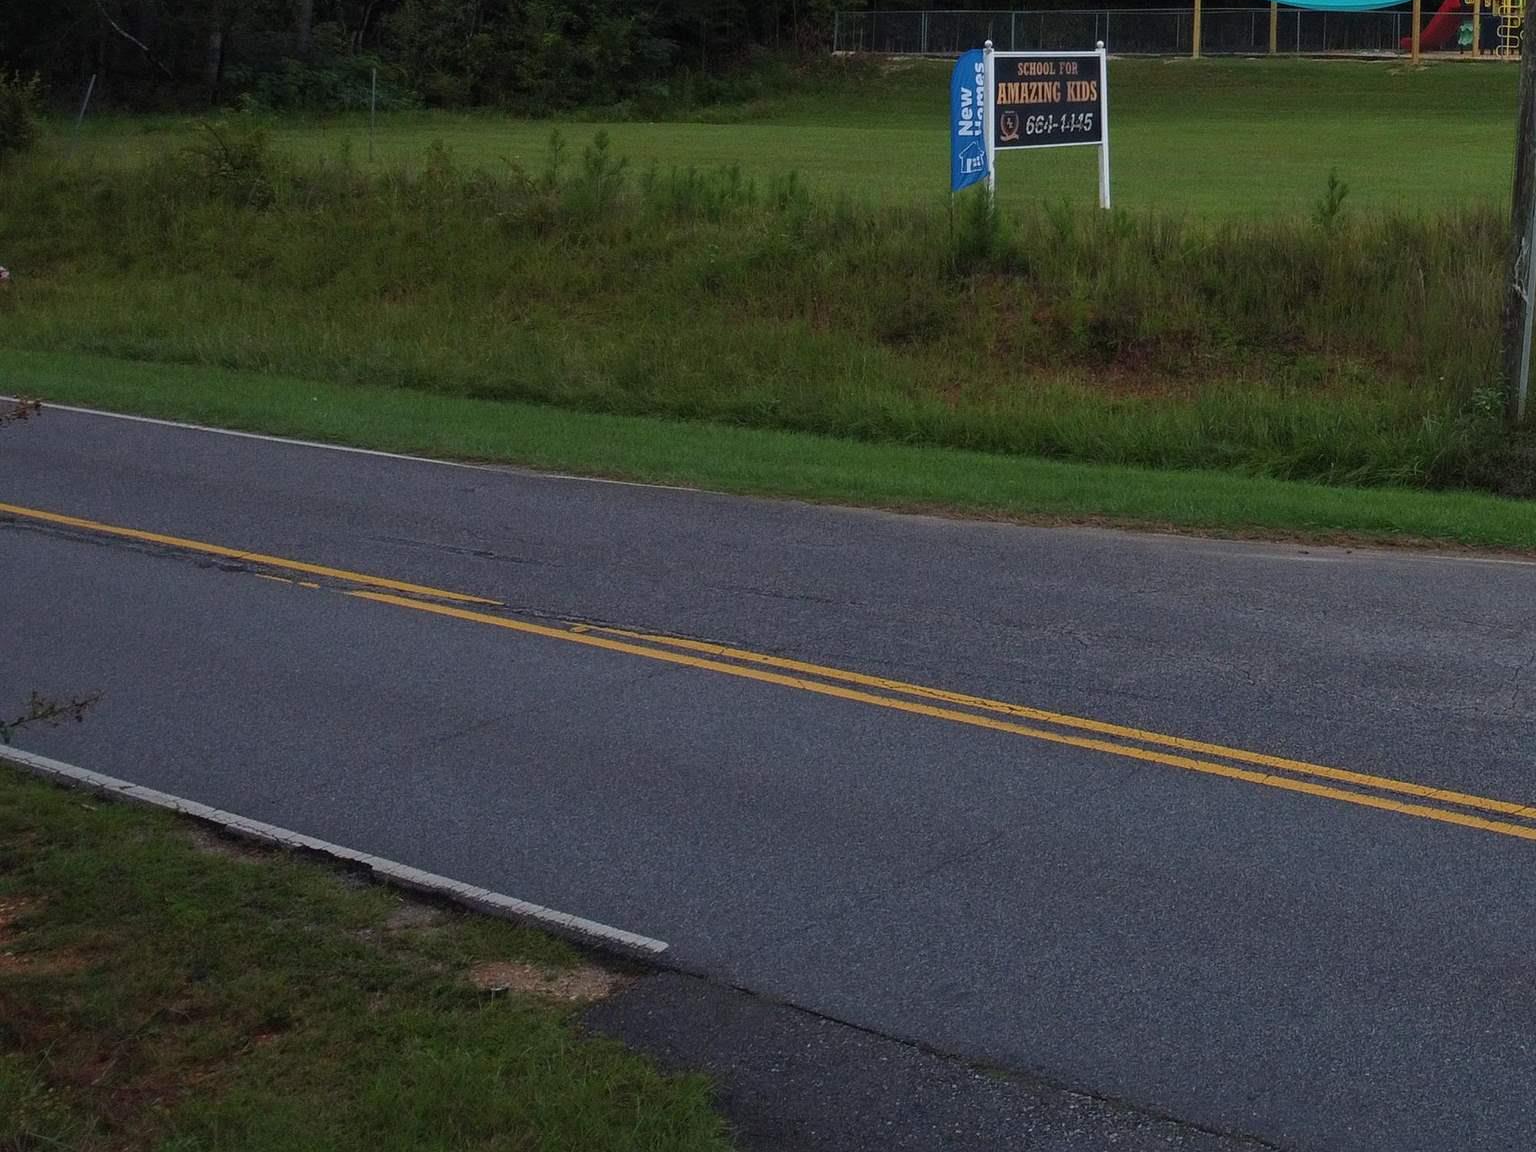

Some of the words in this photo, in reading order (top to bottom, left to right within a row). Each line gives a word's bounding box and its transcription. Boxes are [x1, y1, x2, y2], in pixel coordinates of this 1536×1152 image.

[1017, 62, 1055, 76] SCHOOL
[1059, 61, 1078, 75] FOR
[997, 81, 1061, 105] AMAZING
[1066, 80, 1097, 102] KIDS
[959, 87, 973, 136] New
